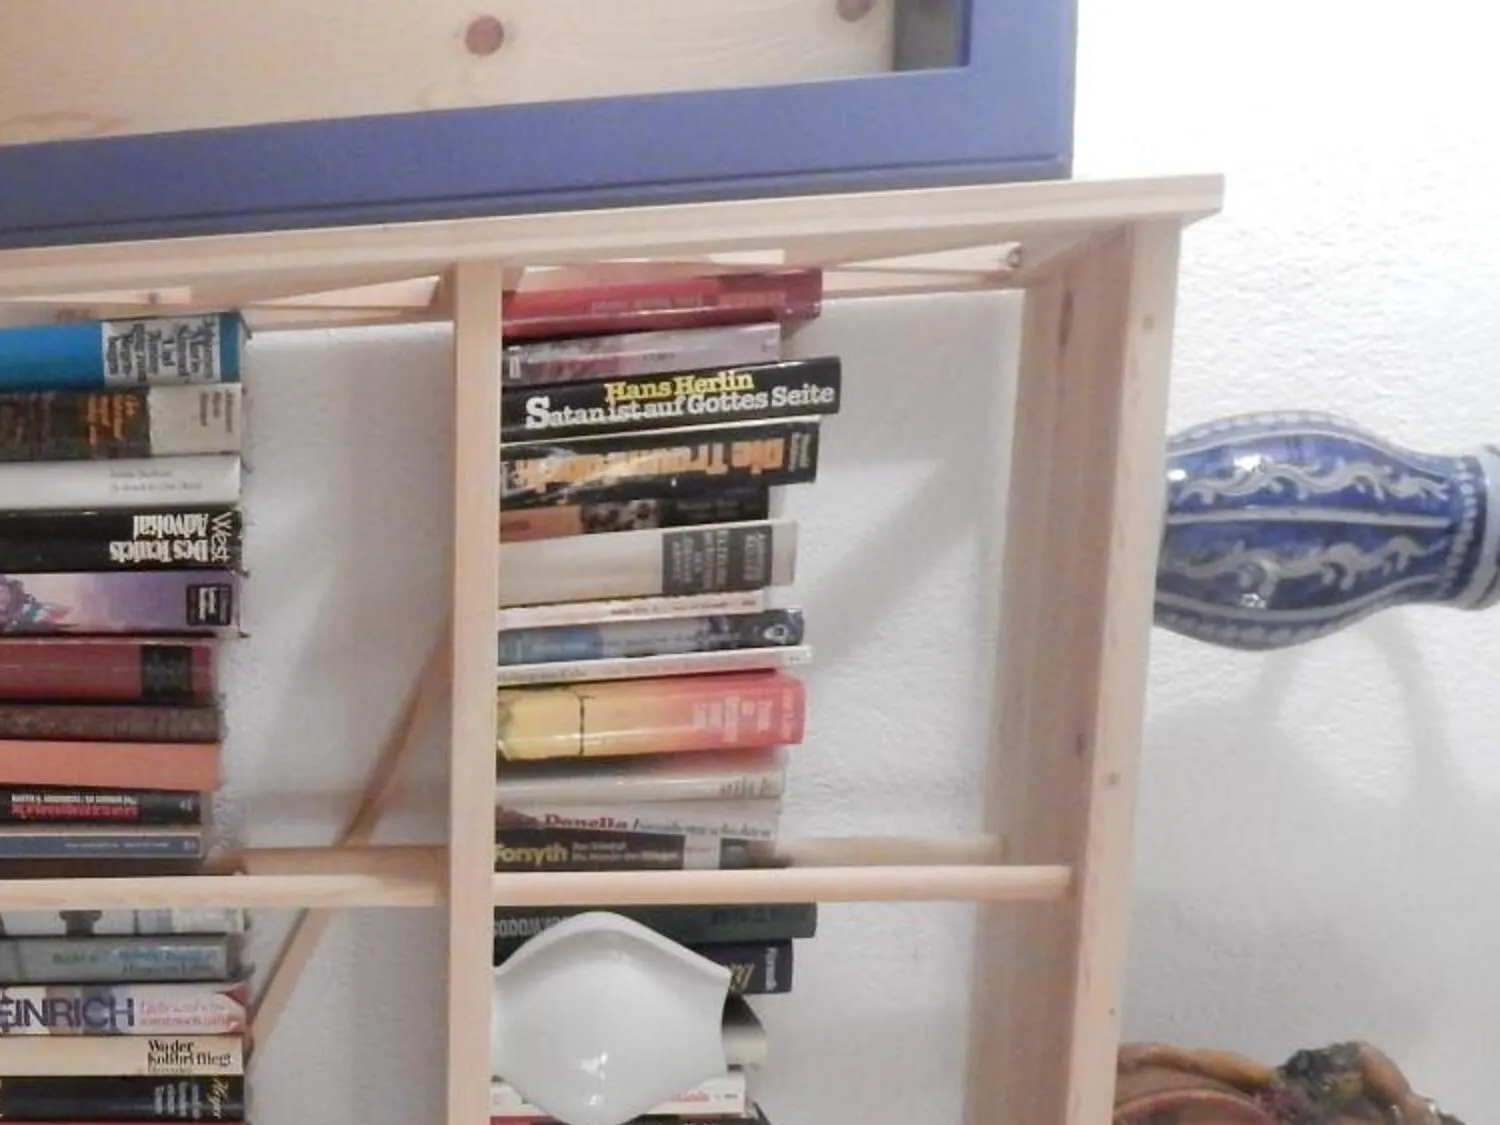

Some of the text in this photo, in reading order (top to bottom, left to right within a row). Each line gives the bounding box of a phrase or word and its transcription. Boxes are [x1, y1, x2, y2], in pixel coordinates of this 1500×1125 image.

[526, 384, 835, 429] Satan ist auf Gottes Seite
[604, 371, 754, 402] Hans Herlin
[210, 512, 232, 564] West
